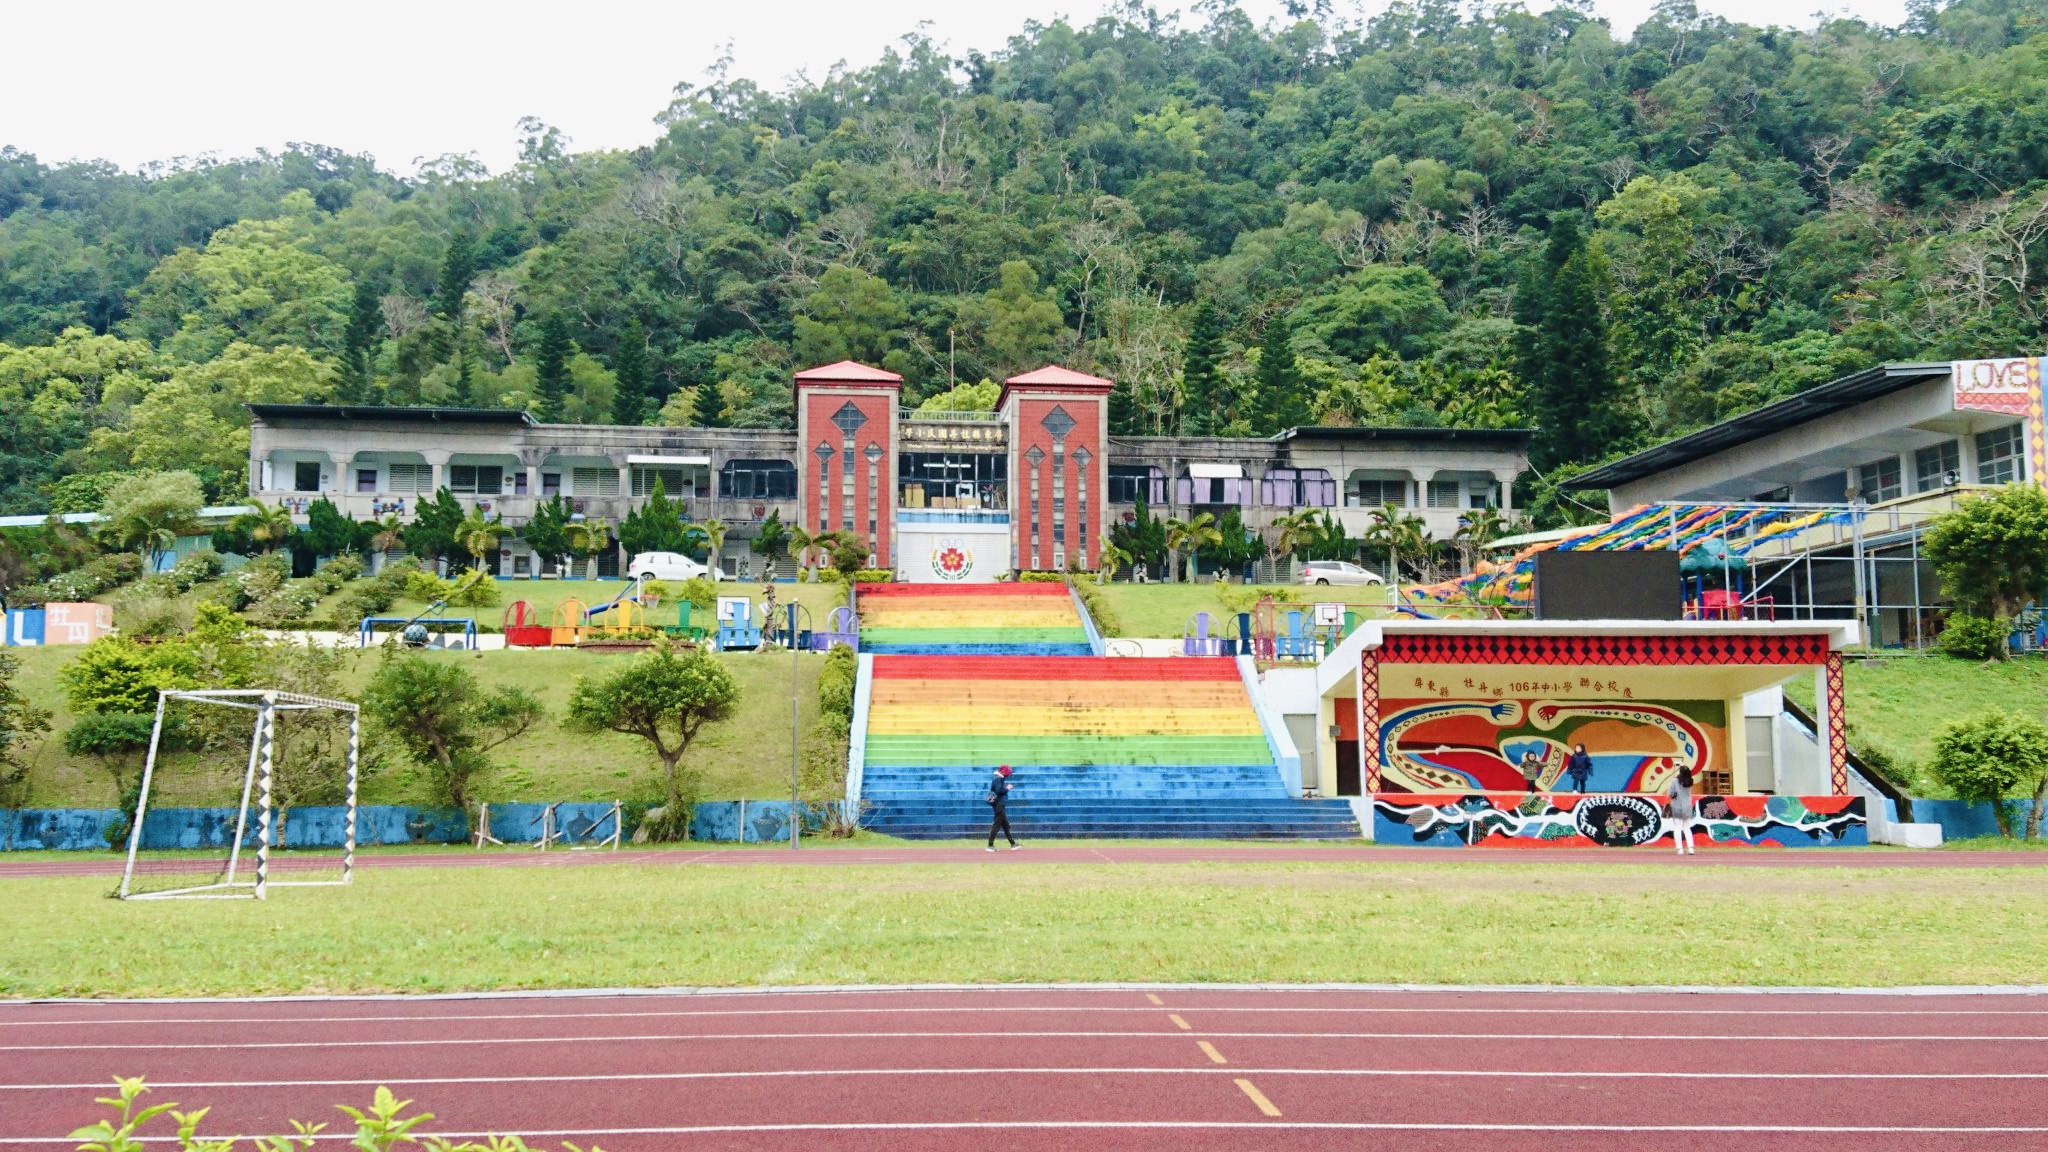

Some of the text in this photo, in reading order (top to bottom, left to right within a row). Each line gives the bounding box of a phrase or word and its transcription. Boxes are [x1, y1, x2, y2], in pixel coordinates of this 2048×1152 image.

[1956, 361, 2027, 392] LOVE
[1579, 677, 1634, 698] 聯合校慶
